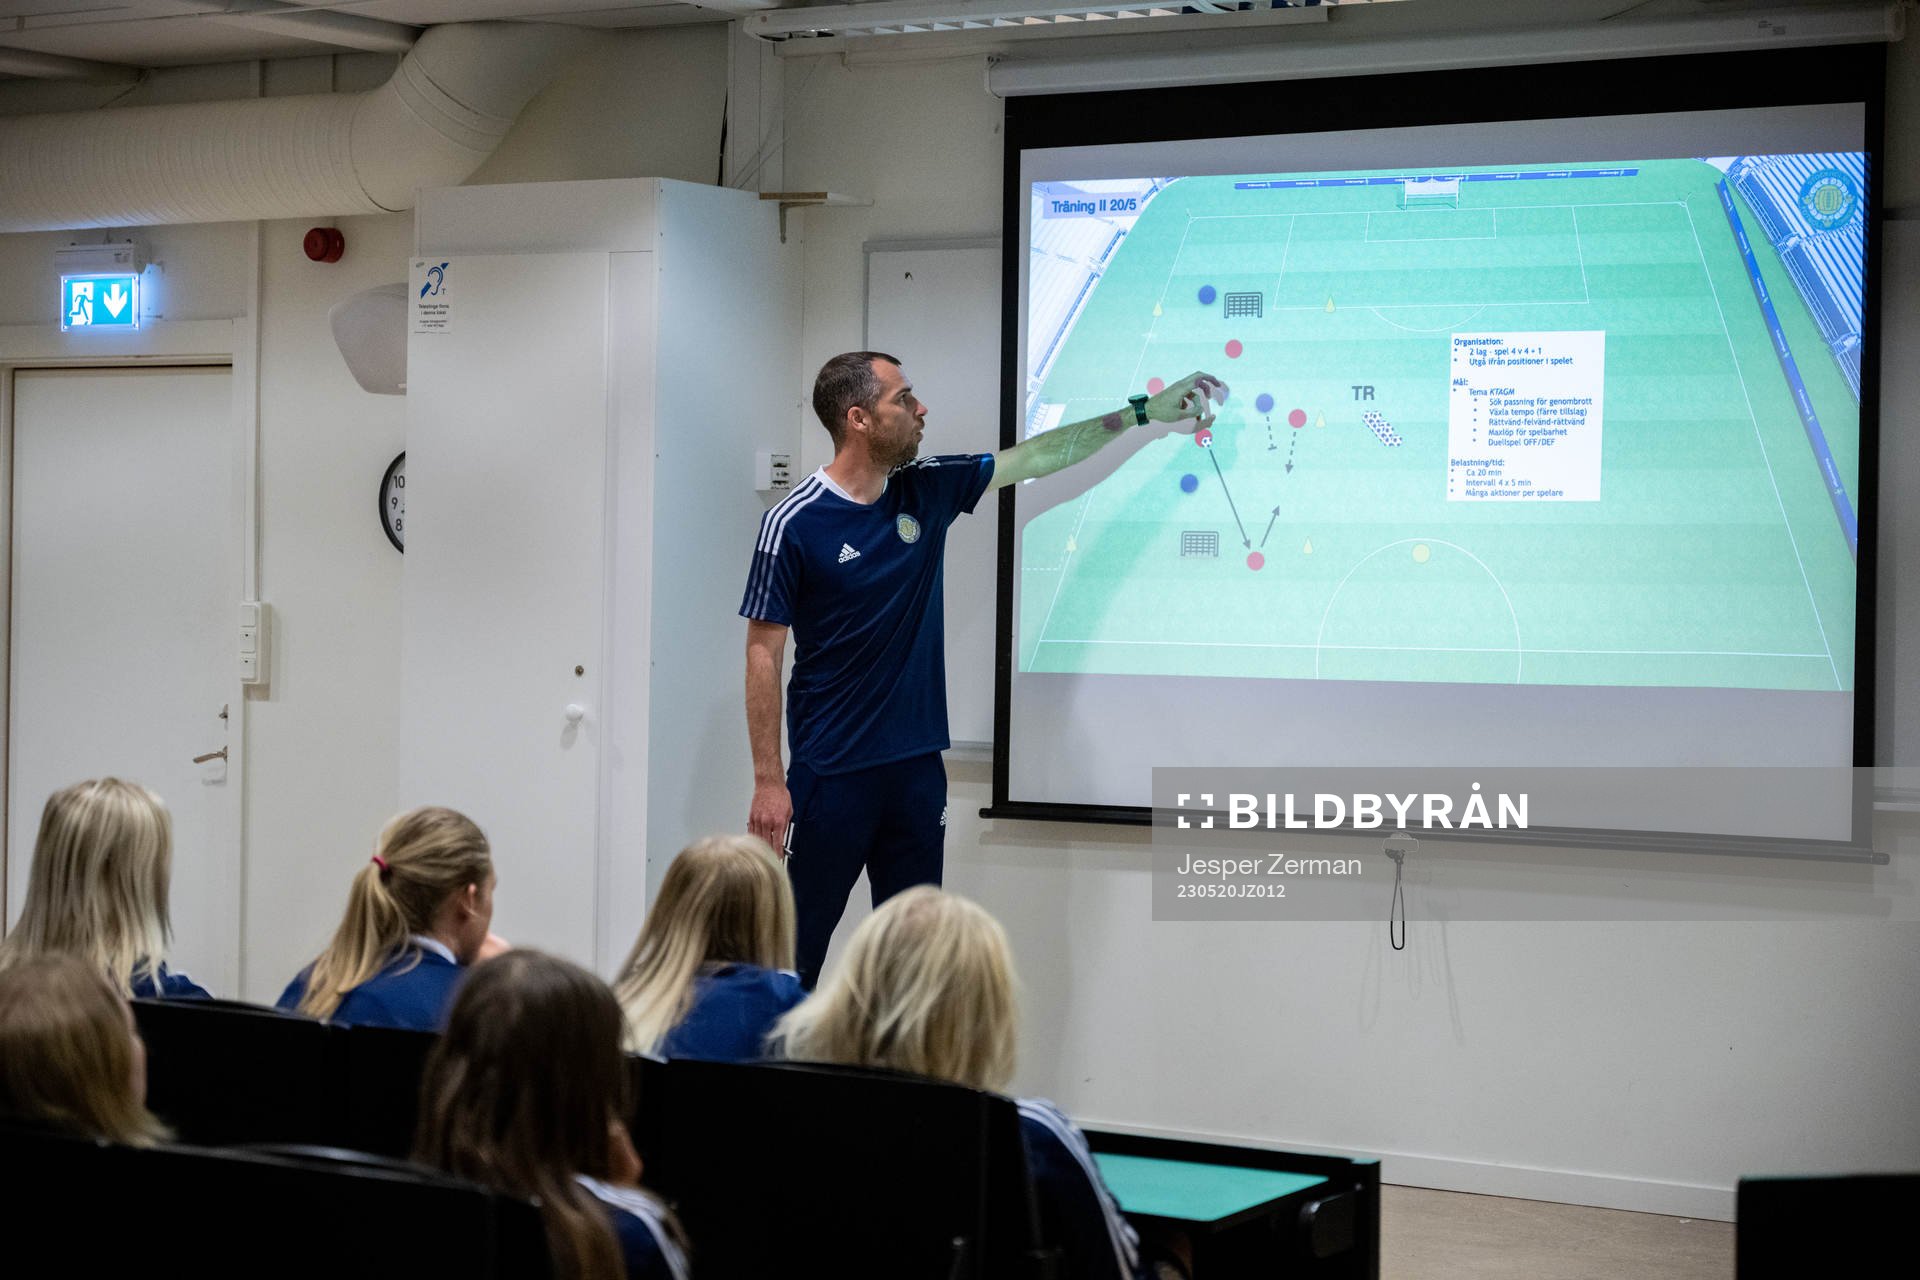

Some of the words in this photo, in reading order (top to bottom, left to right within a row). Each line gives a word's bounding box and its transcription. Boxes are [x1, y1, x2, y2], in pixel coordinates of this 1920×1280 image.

[1052, 200, 1095, 214] Träning
[1110, 198, 1137, 211] 20/5
[1454, 338, 1503, 347] Organisation:
[1476, 348, 1487, 357] lag
[1494, 347, 1509, 357] spel
[1469, 357, 1486, 367] Utgå
[1488, 356, 1505, 365] ifrån
[1507, 357, 1544, 366] positioner
[1550, 357, 1573, 366] spelet
[1453, 378, 1468, 386] Mål:
[1352, 385, 1375, 400] TR
[1469, 388, 1488, 396] Tema
[1489, 388, 1515, 396] KTAGM
[1489, 398, 1502, 406] Sök
[1504, 398, 1535, 407] passning
[1536, 397, 1547, 405] för
[1549, 397, 1592, 407] genombrott
[1489, 408, 1509, 416] Växla
[1511, 408, 1535, 417] tempo
[1536, 407, 1557, 416] (färre
[1559, 407, 1587, 417] tillslag)
[1488, 428, 1514, 437] Maxlöp
[1516, 428, 1526, 436] för
[1528, 428, 1568, 437] spelbarhet
[1488, 438, 1521, 447] Duellspel
[1523, 438, 1555, 446] OFF/DEF
[1451, 458, 1505, 468] Belastning/tid:
[394, 475, 405, 488] 10
[1465, 488, 1488, 498] Många
[1490, 489, 1520, 497] aktioner
[1522, 490, 1534, 498] per
[1537, 489, 1563, 498] spelare
[391, 497, 398, 510] 9
[395, 518, 402, 531] 8
[838, 551, 861, 564] adidas
